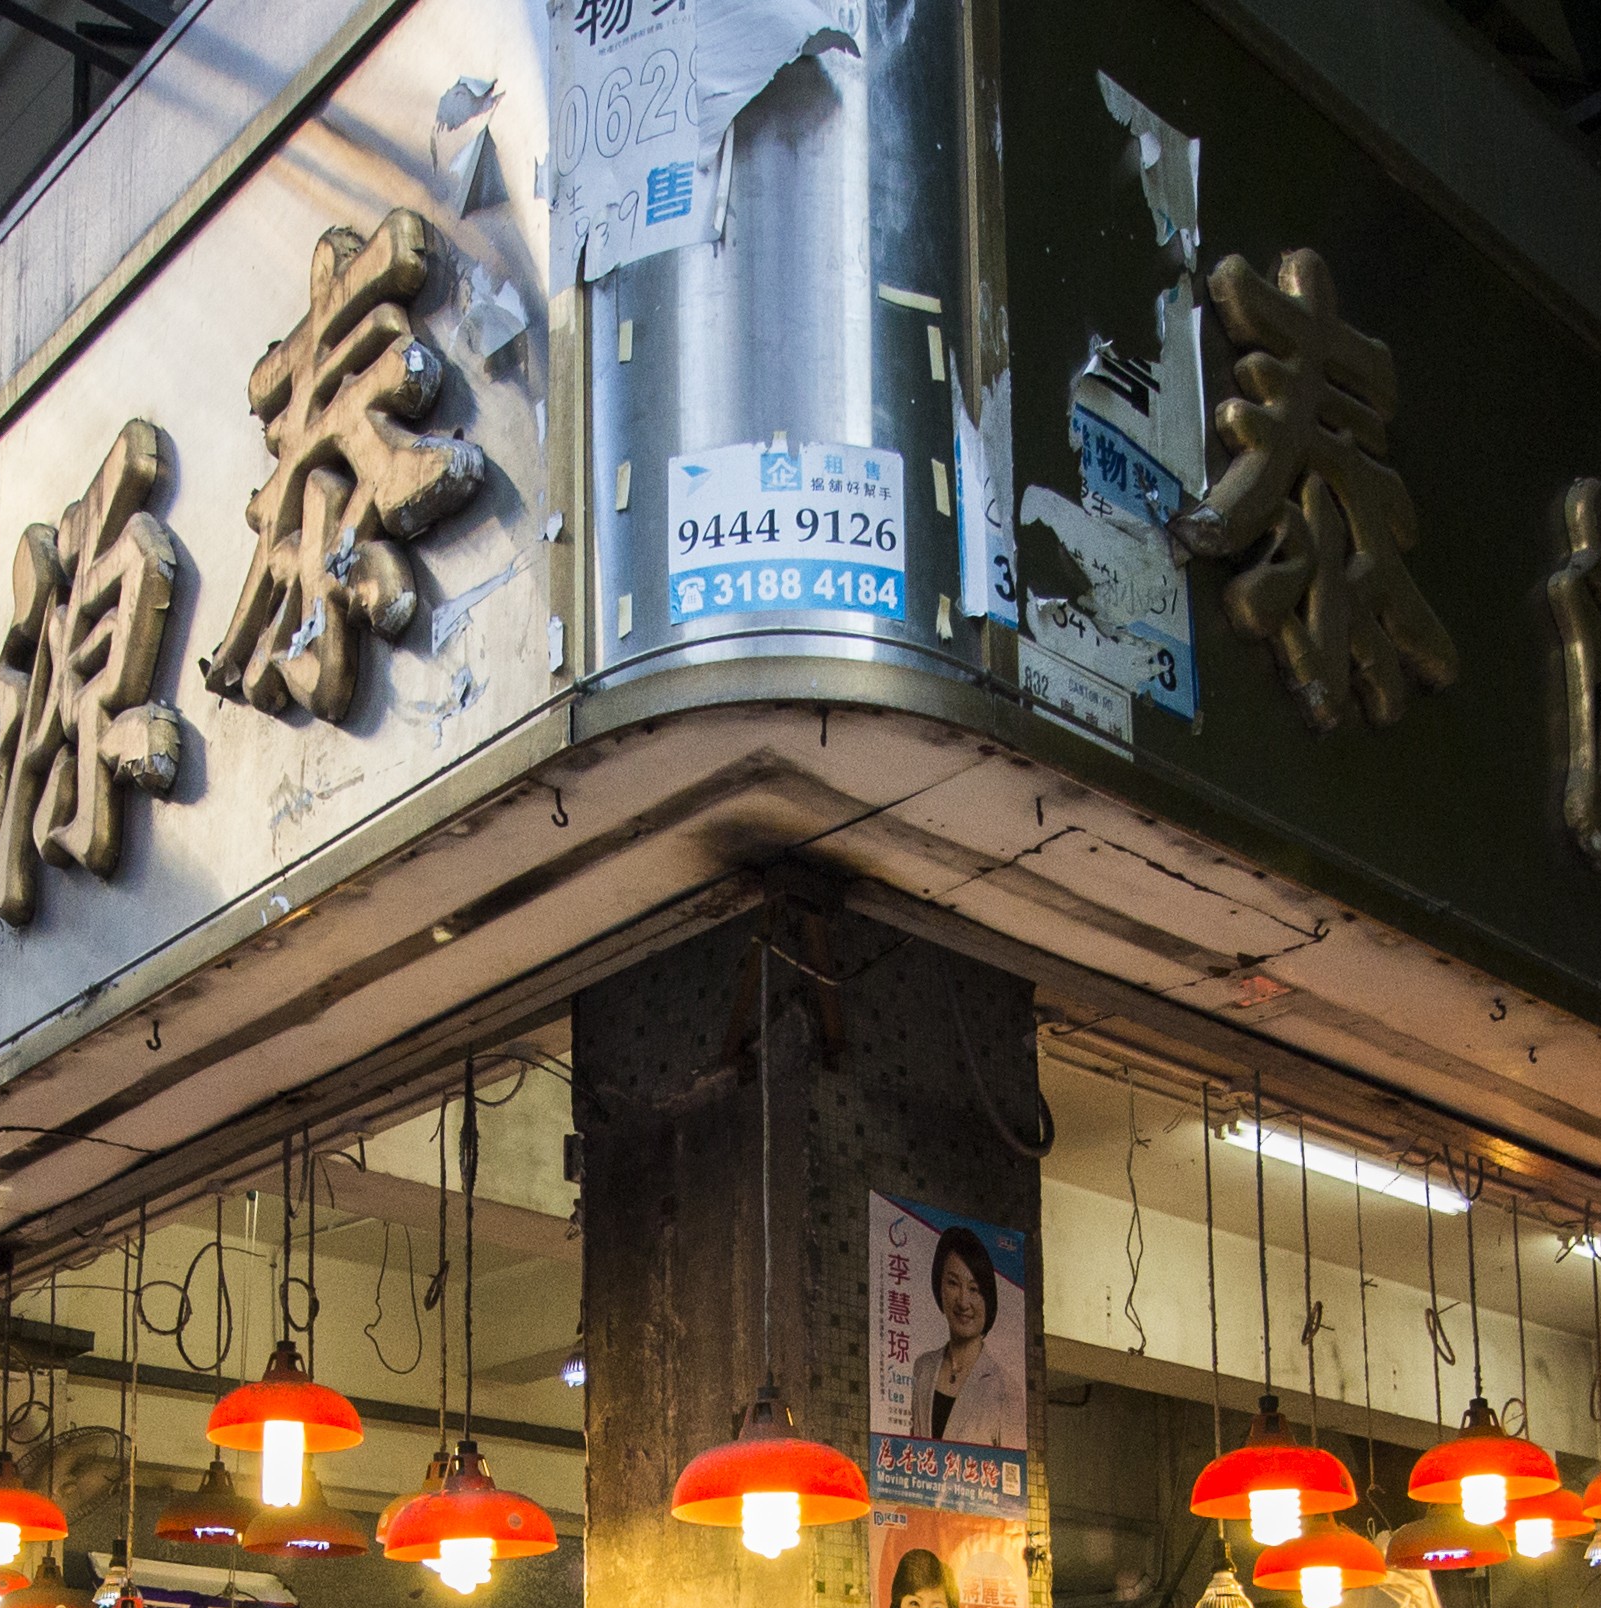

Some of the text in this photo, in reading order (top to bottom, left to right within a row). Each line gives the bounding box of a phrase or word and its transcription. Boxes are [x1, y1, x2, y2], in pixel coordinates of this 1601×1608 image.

[646, 161, 695, 227] 售
[766, 457, 798, 488] 企
[678, 508, 898, 556] 9444 9126
[713, 568, 899, 609] 3188 4184
[1024, 665, 1050, 699] 832
[887, 1254, 911, 1364] 李慧琼
[876, 1470, 1000, 1505] Moving Forward Hong Kong
